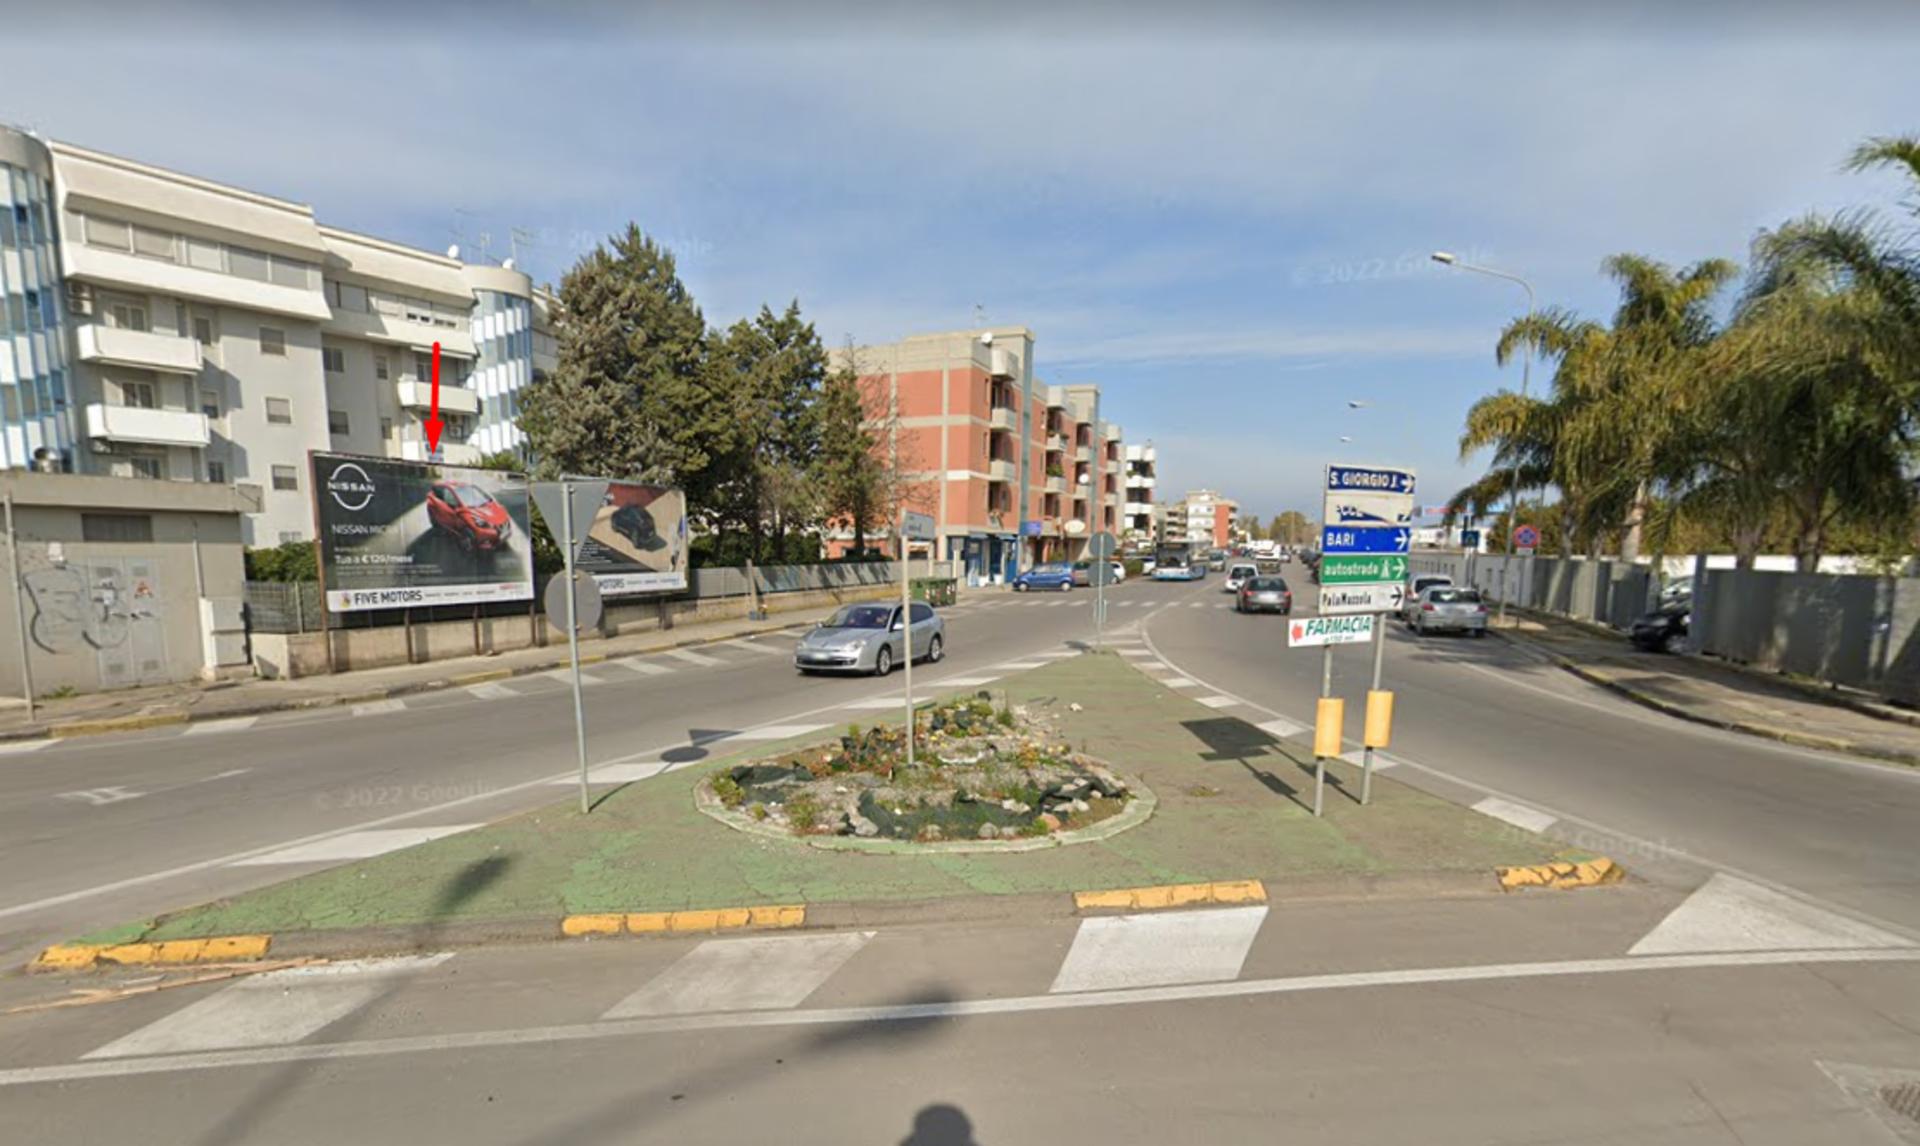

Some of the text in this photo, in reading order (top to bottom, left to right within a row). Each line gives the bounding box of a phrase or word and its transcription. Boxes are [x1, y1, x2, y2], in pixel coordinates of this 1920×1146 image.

[327, 481, 376, 492] NISSAN
[1342, 471, 1389, 488] GIORGIO
[331, 523, 368, 535] NISSAN
[1326, 532, 1355, 547] BARI
[354, 593, 378, 605] FIVE
[381, 590, 423, 604] MOTORS
[1305, 616, 1371, 637] FARMACIA
